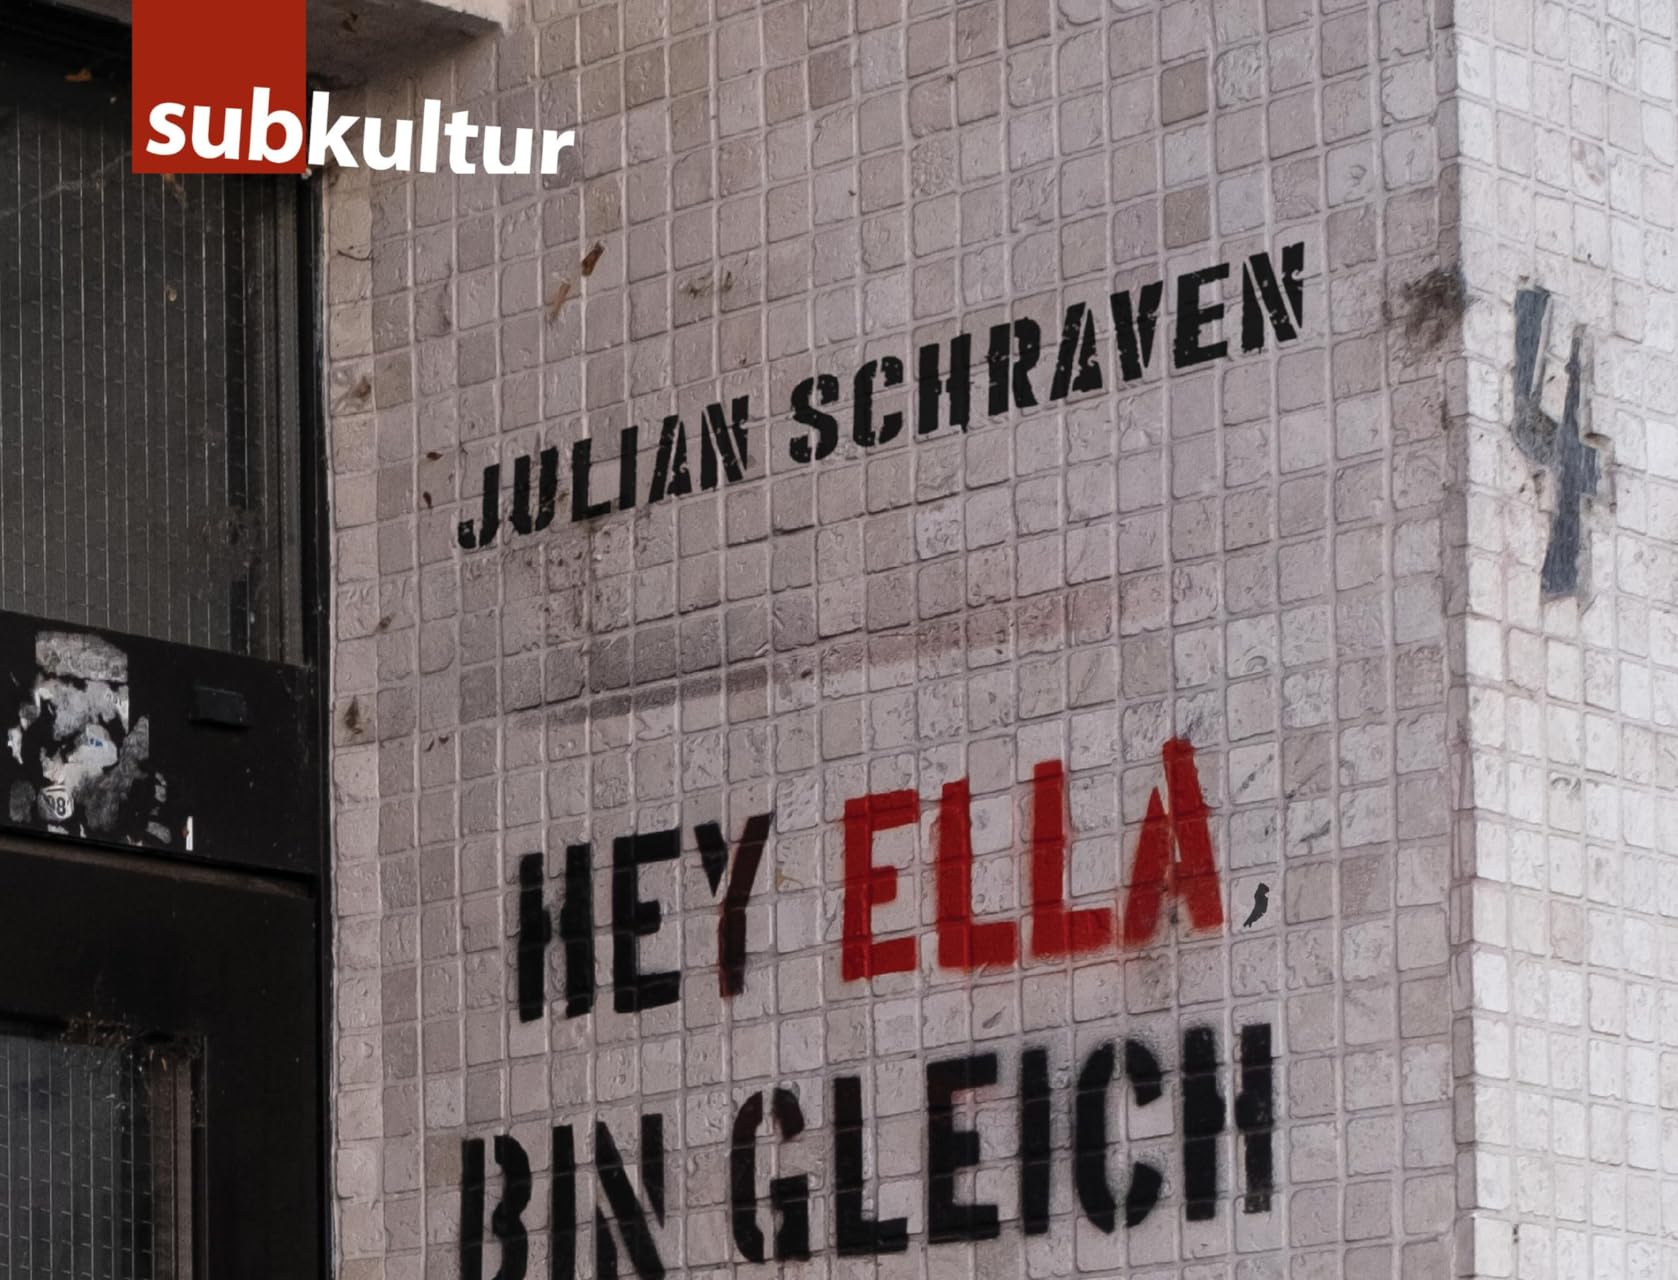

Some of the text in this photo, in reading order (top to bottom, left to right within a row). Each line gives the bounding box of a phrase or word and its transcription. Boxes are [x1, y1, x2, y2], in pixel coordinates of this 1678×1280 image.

[458, 243, 1304, 550] JULIAN SCHRAVEN
[516, 739, 1269, 1023] HEY ELLA,
[729, 1022, 1275, 1265] GLEICH
